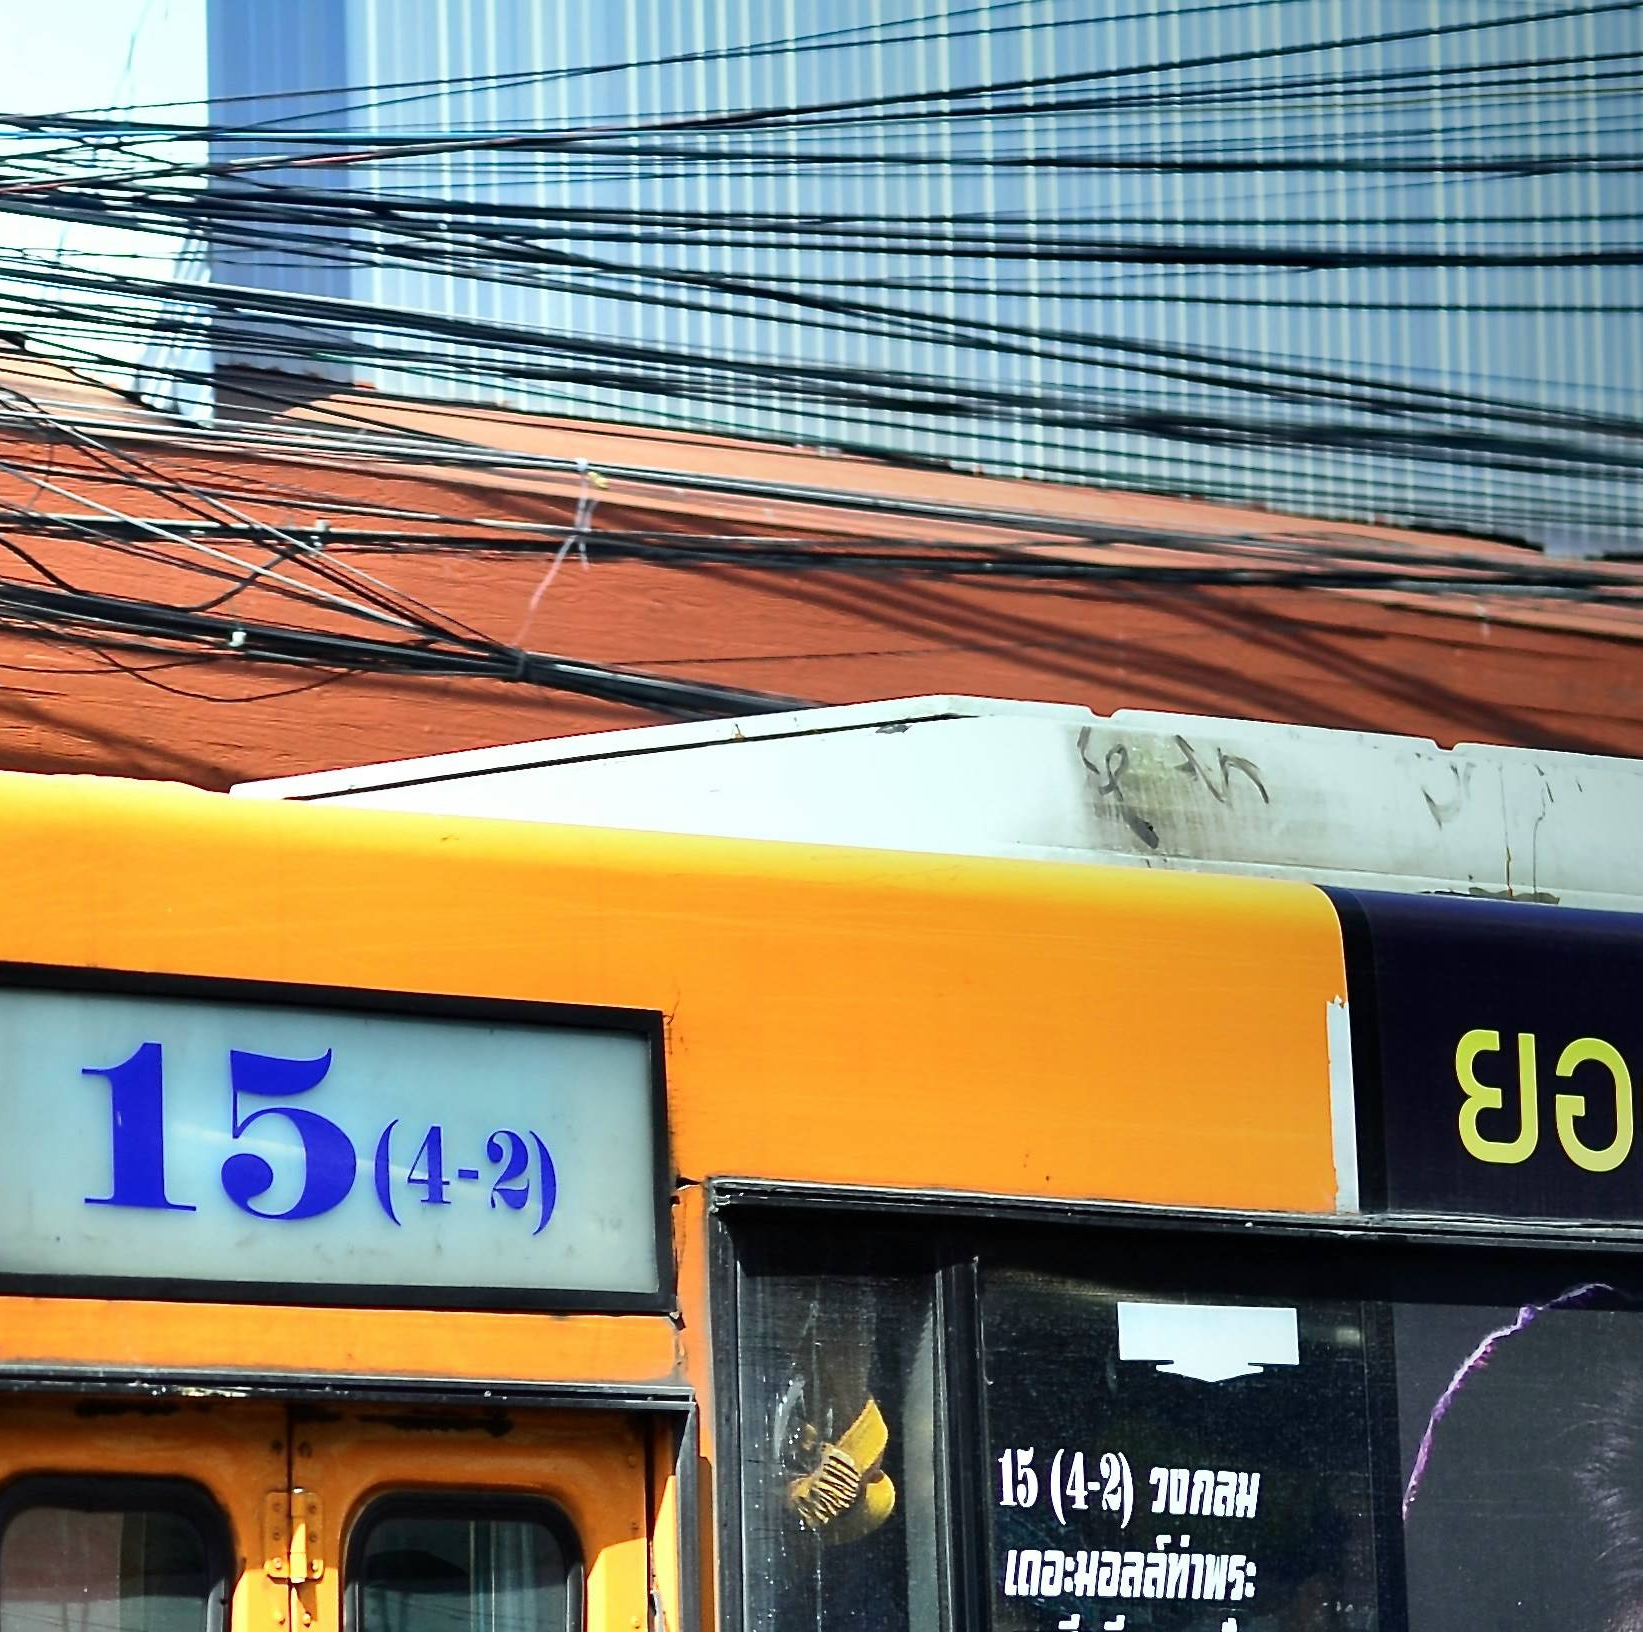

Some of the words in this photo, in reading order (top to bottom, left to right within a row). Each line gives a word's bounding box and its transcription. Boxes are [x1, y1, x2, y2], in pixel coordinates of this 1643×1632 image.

[81, 1042, 356, 1220] 15
[374, 1119, 557, 1236] (4-2)
[998, 1446, 1039, 1508] 15
[1050, 1448, 1134, 1528] (4-2)
[1149, 1467, 1260, 1519] วงกลม
[1004, 1534, 1257, 1601] เดอะมอลล์ท่าพระ
